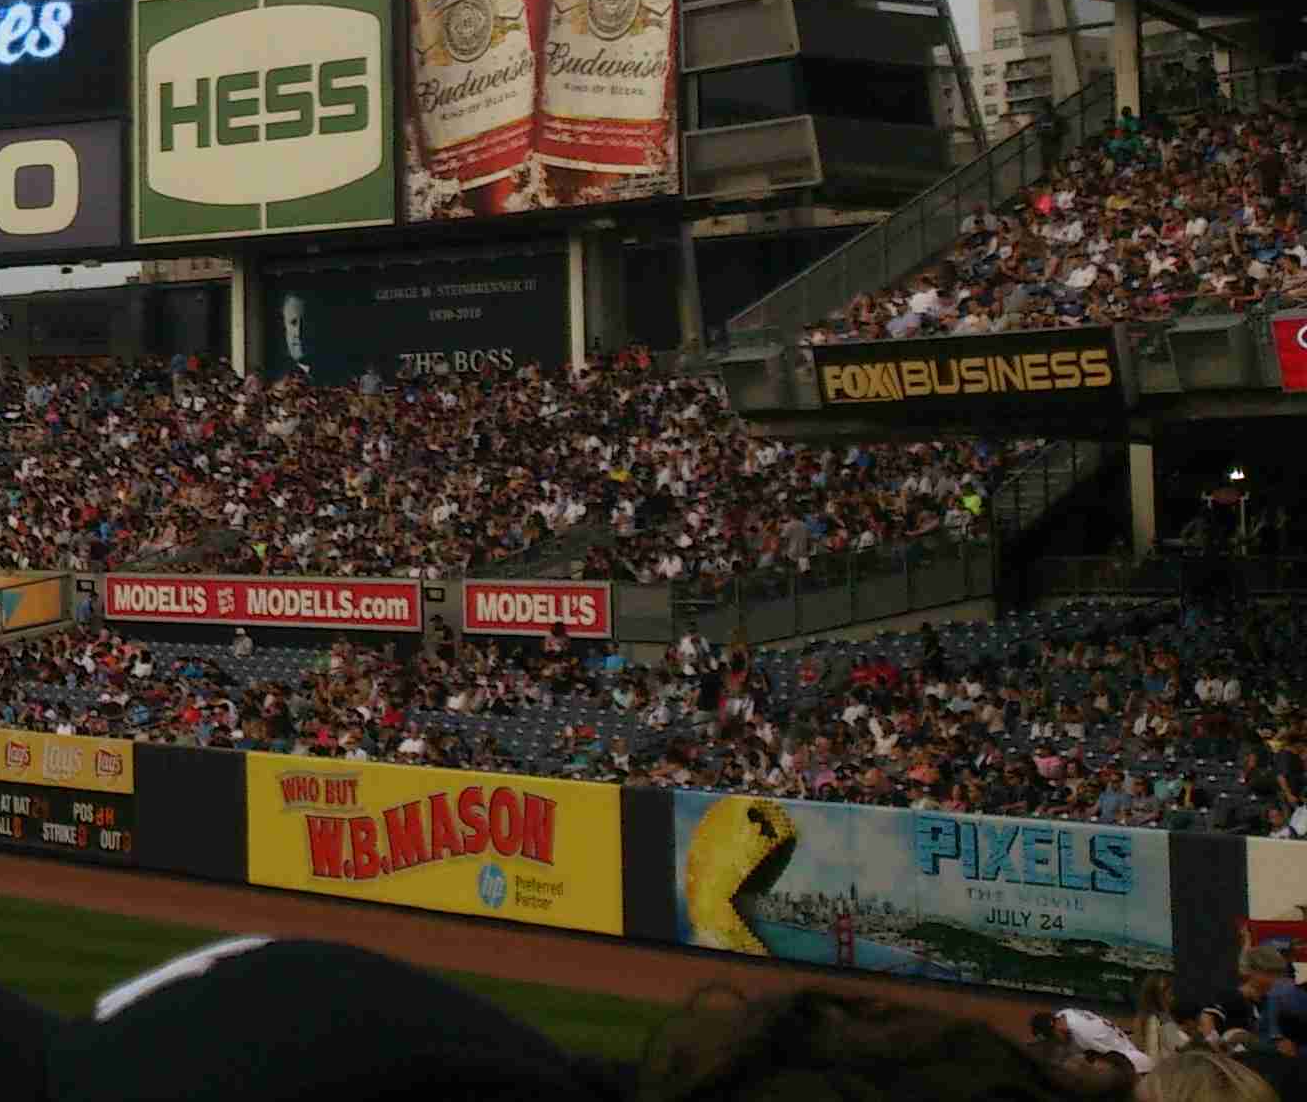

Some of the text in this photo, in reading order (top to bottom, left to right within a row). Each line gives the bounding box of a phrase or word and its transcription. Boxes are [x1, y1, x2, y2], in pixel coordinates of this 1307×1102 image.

[159, 56, 370, 153] HESS
[454, 347, 515, 374] BOSS
[902, 346, 1114, 397] BUSINESS
[113, 584, 207, 614] MODELL'S
[246, 585, 409, 620] MODELLS.com
[475, 592, 597, 624] MODELL'S
[282, 778, 359, 805] WHO BUT
[0, 794, 11, 812] AT
[73, 803, 93, 823] POS
[43, 822, 76, 844] STRIKE
[100, 830, 122, 850] OUT
[916, 815, 1133, 895] PIXELS
[986, 907, 1065, 931] JULY 24
